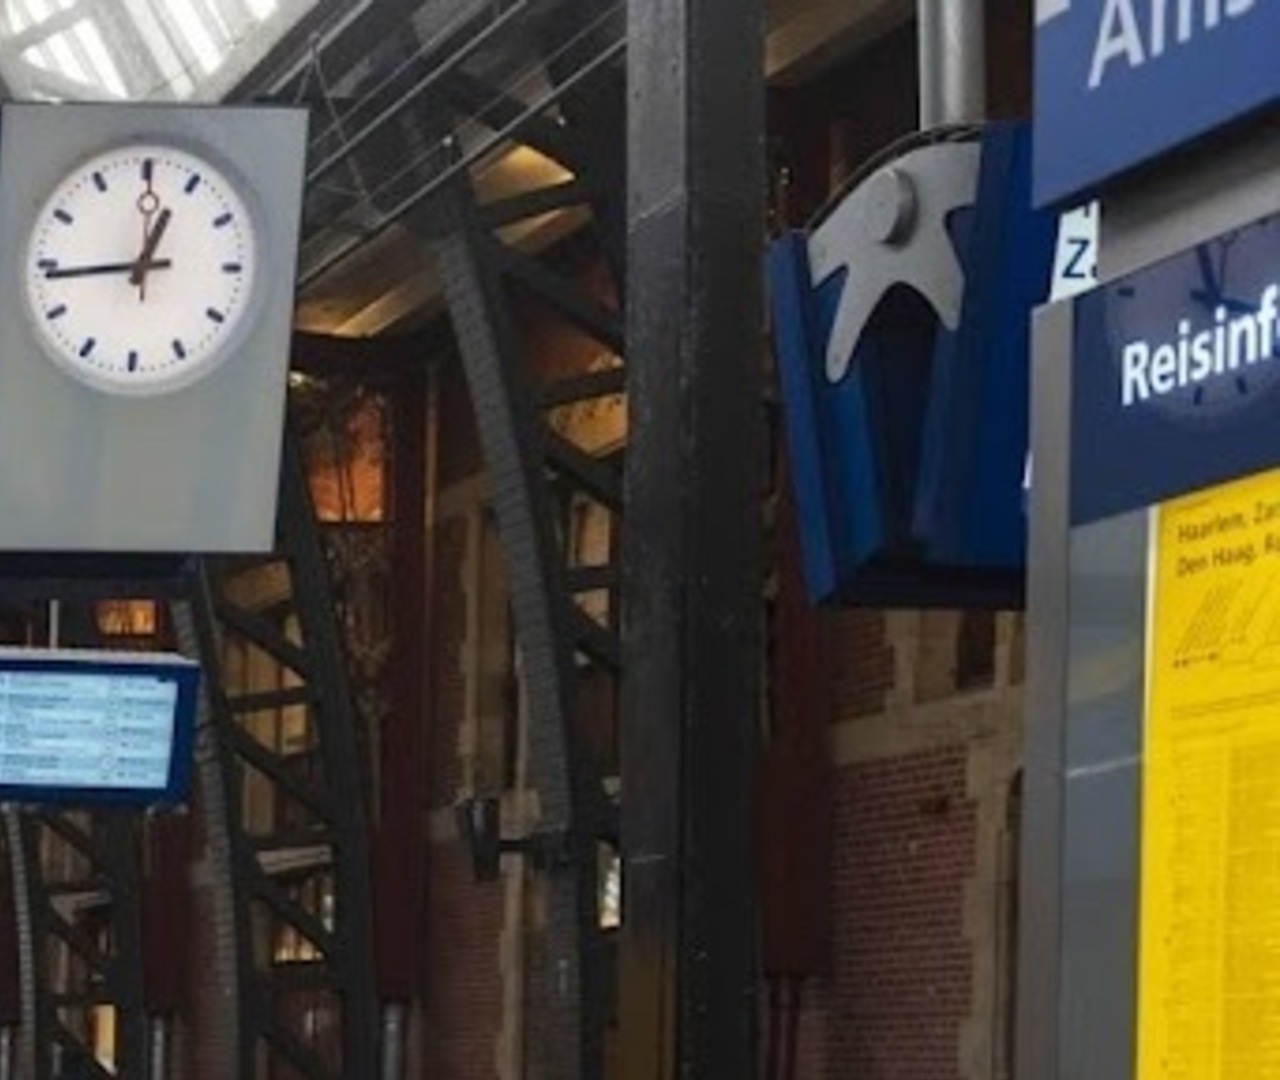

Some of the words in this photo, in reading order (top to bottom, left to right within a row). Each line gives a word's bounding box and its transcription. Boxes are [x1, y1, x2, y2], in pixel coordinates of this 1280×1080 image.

[1088, 0, 1256, 89] Am
[1062, 238, 1097, 279] Z
[1122, 288, 1280, 407] Reisinf
